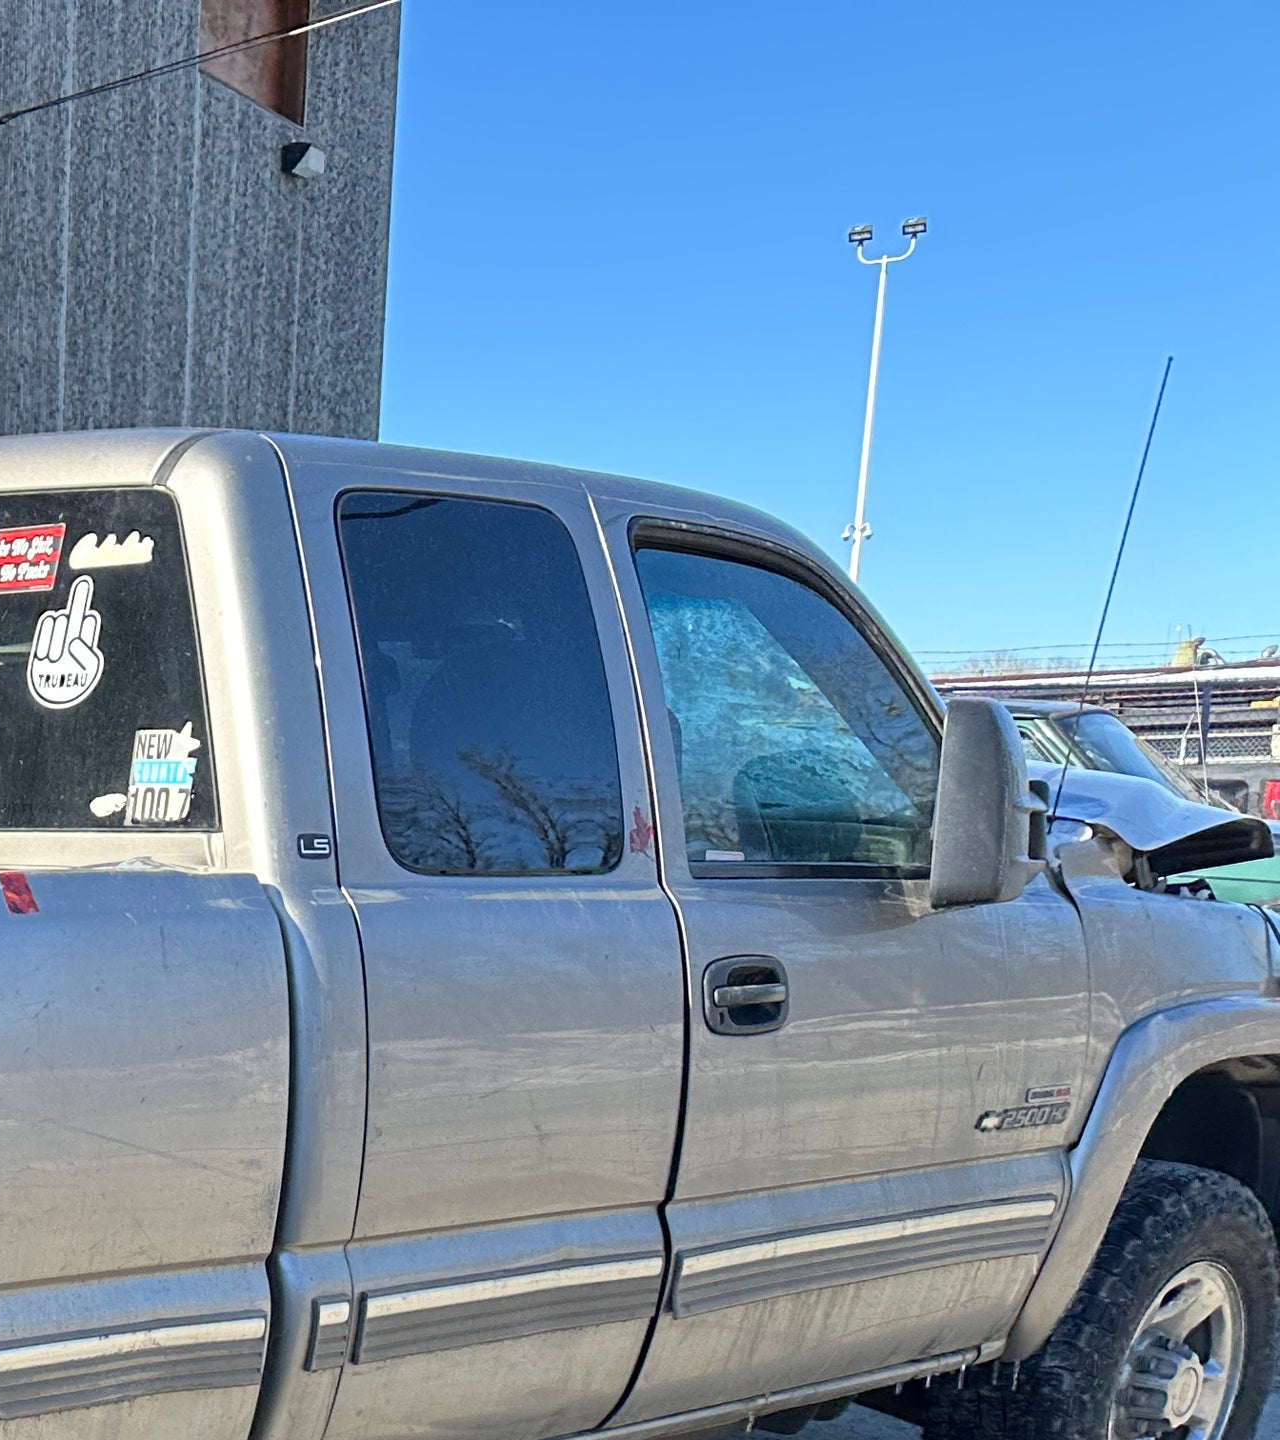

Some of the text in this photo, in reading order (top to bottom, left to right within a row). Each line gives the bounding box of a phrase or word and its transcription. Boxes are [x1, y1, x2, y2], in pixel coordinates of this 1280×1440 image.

[38, 672, 89, 689] TRUDEAU
[136, 733, 174, 760] NEW
[133, 762, 192, 783] COUNT
